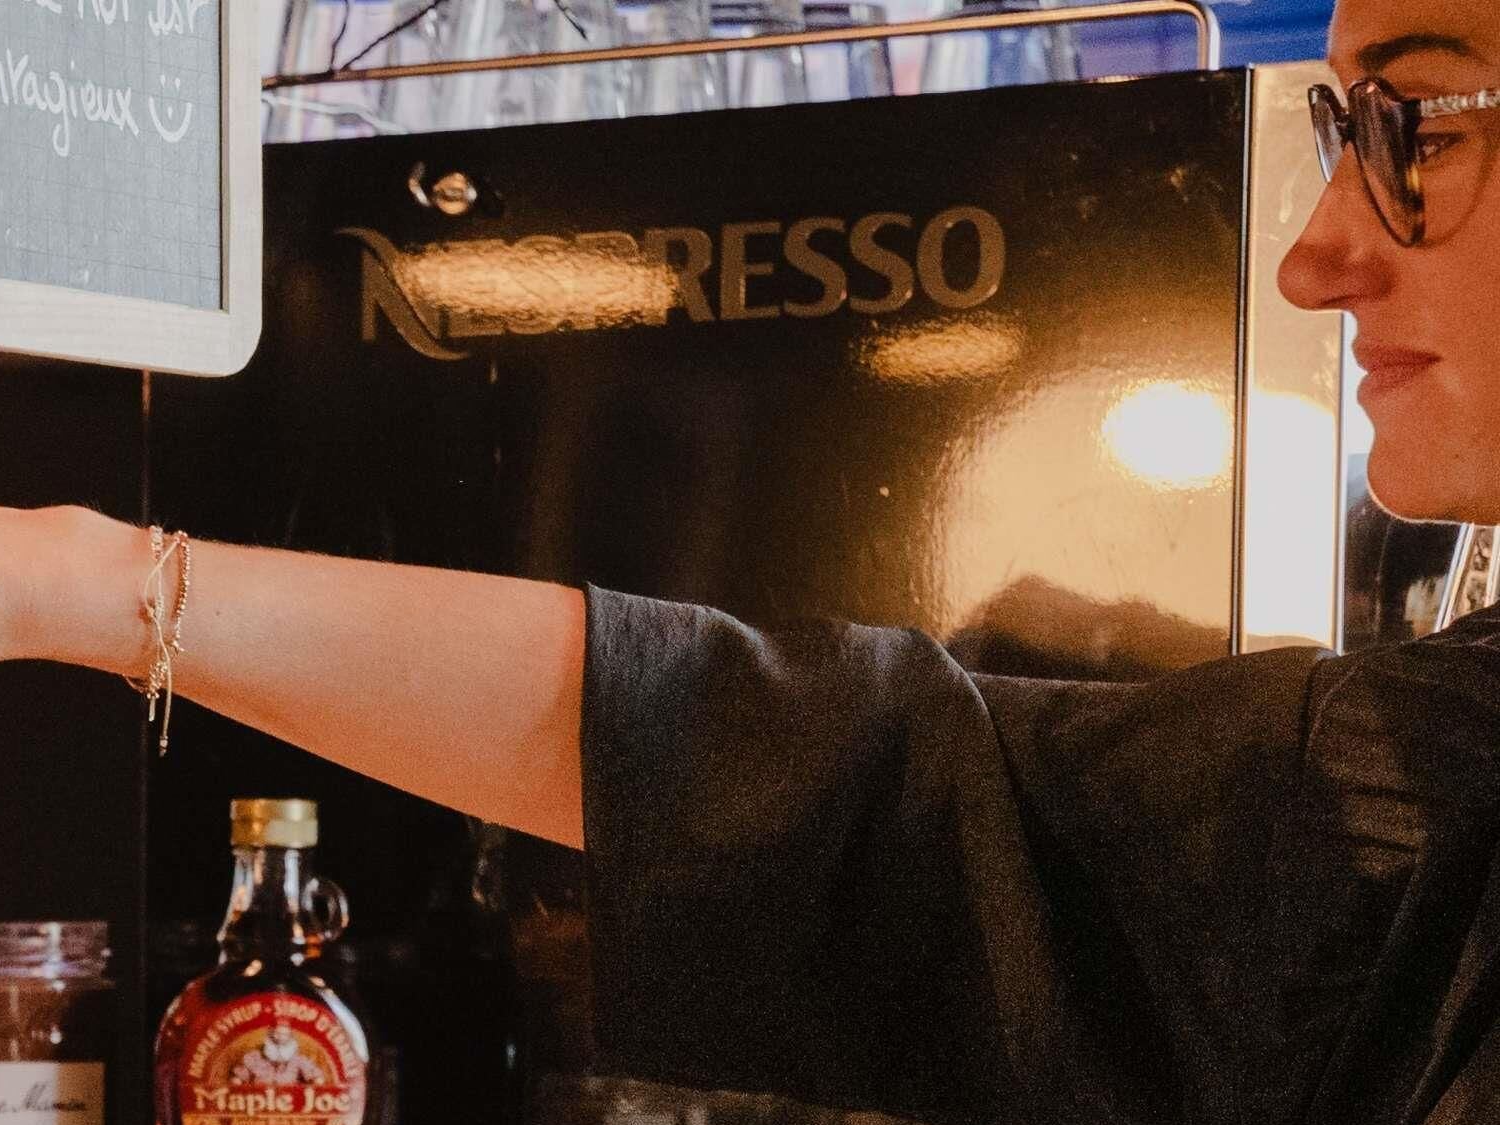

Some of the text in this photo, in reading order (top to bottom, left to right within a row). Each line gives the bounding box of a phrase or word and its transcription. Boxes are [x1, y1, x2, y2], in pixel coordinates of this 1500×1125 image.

[334, 205, 1007, 360] NRESSO
[194, 1086, 350, 1117] Maple Joe
